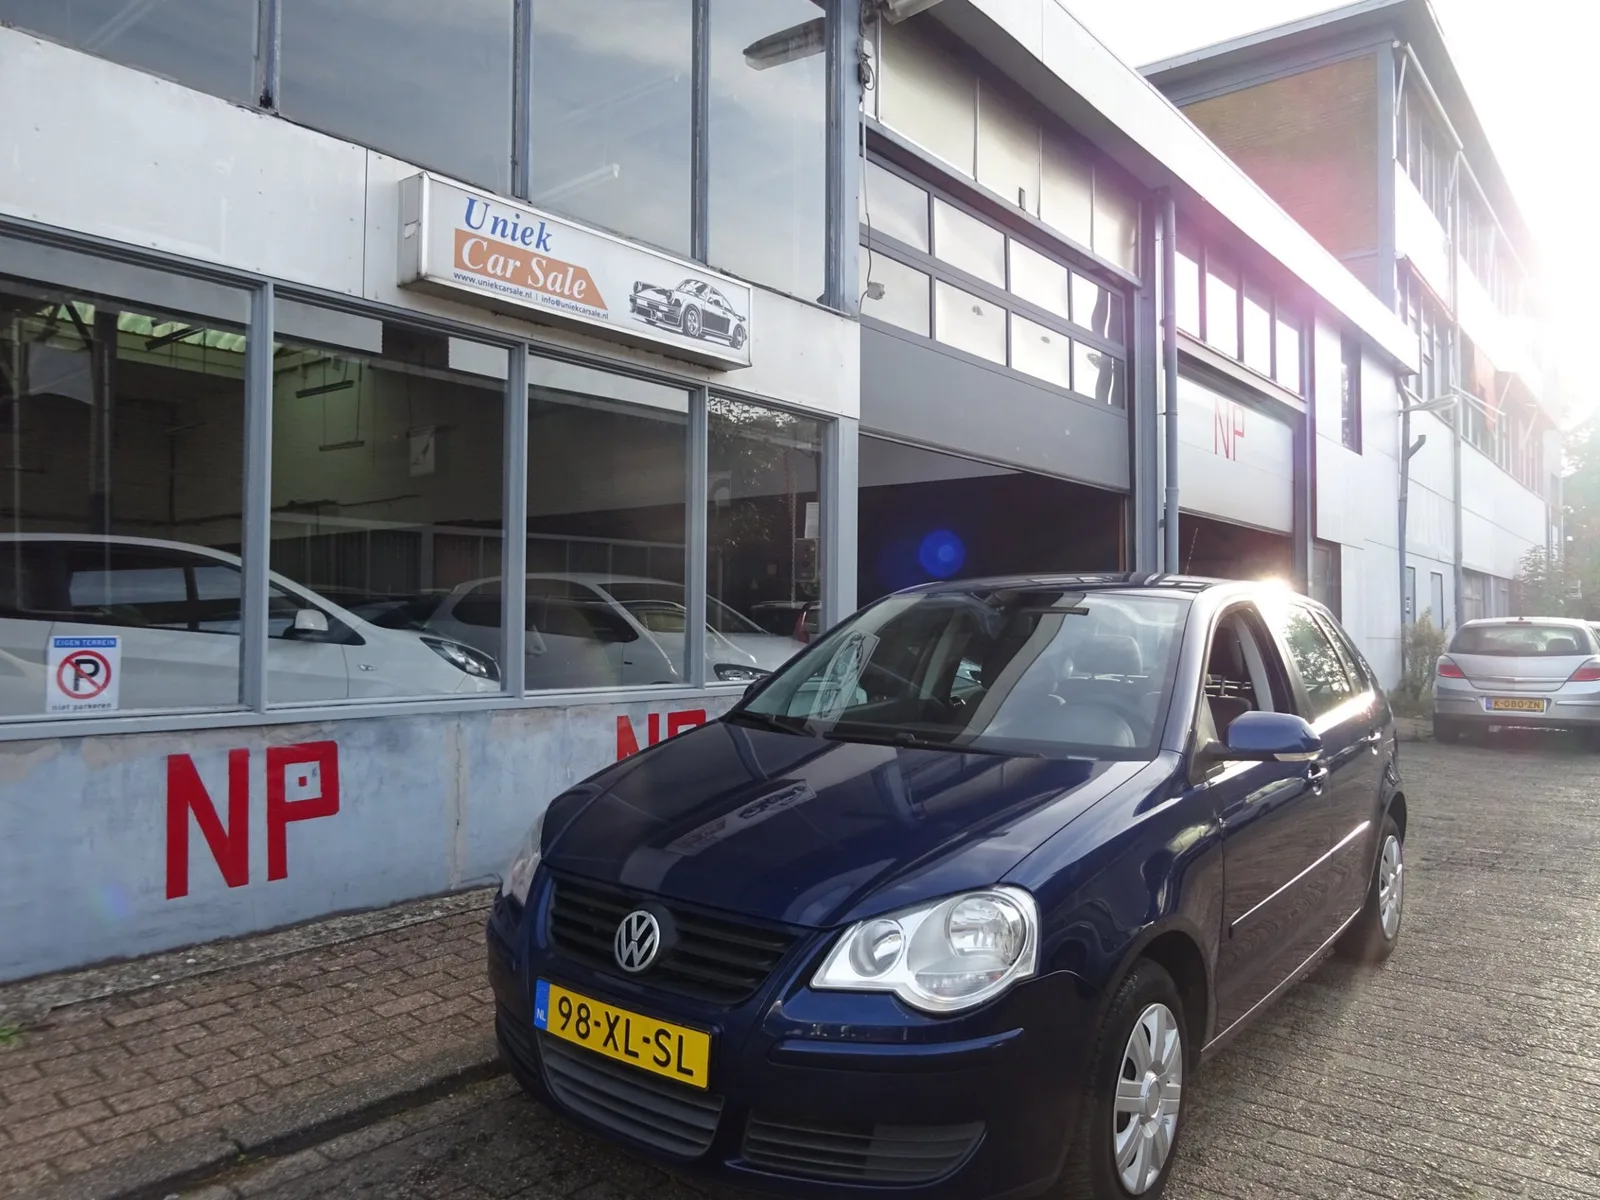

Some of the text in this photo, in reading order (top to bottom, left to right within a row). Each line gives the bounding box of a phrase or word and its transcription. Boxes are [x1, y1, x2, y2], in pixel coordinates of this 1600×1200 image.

[465, 196, 553, 252] Uniek
[453, 271, 609, 320] www.uniekcarsale.nl info@uniekcarsale.nl
[461, 237, 588, 300] Car Sale
[1214, 397, 1245, 461] NP
[52, 702, 112, 711] niet parkeren
[165, 740, 340, 900] NP
[536, 995, 694, 1077] NL 98-XL-SL
